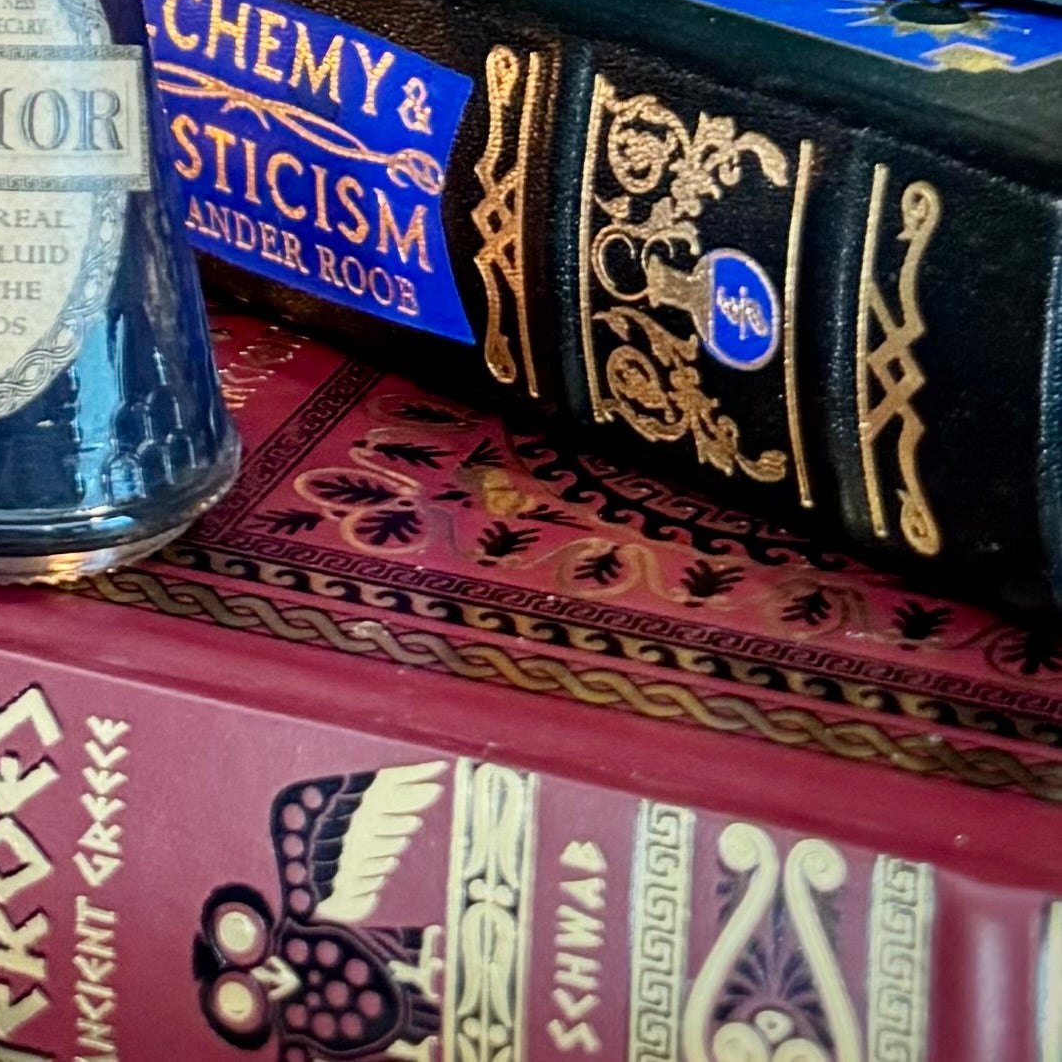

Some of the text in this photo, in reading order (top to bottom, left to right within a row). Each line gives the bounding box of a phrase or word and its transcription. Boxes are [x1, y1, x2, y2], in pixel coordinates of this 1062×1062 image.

[169, 113, 435, 274] STICISM
[184, 195, 310, 276] ANDER
[73, 715, 131, 887] GREECE
[547, 840, 608, 1054] SCHWAB
